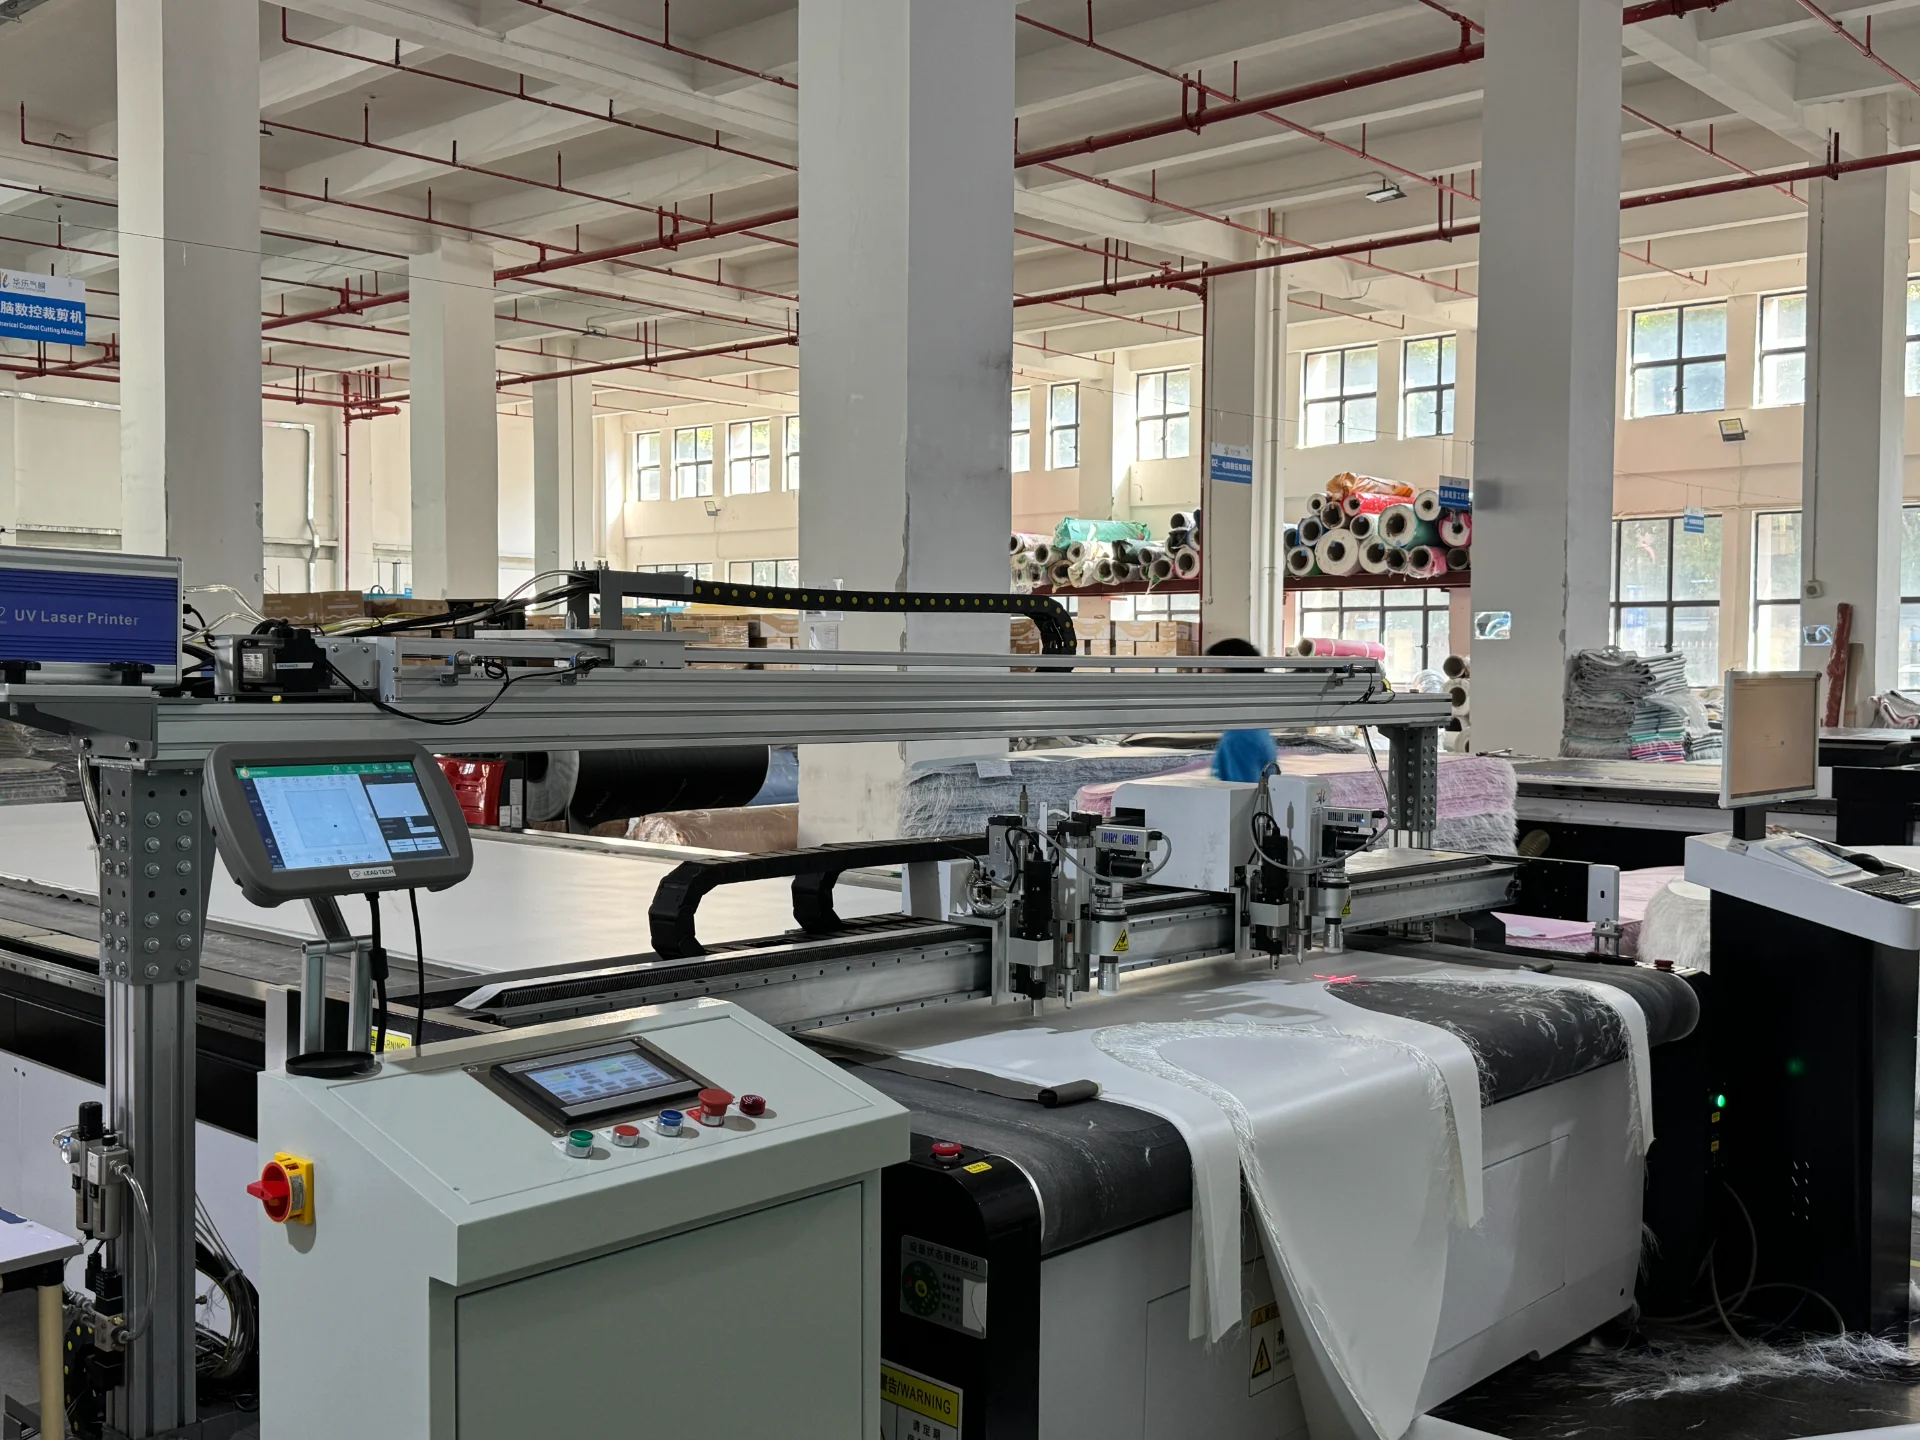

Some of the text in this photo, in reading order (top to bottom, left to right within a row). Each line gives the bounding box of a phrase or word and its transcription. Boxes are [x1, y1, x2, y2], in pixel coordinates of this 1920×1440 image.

[0, 300, 84, 324] 脑数控裁剪机
[19, 322, 40, 331] Control
[40, 325, 61, 335] Cutting
[60, 328, 84, 337] Machine
[14, 609, 139, 626] UV Laser Printer
